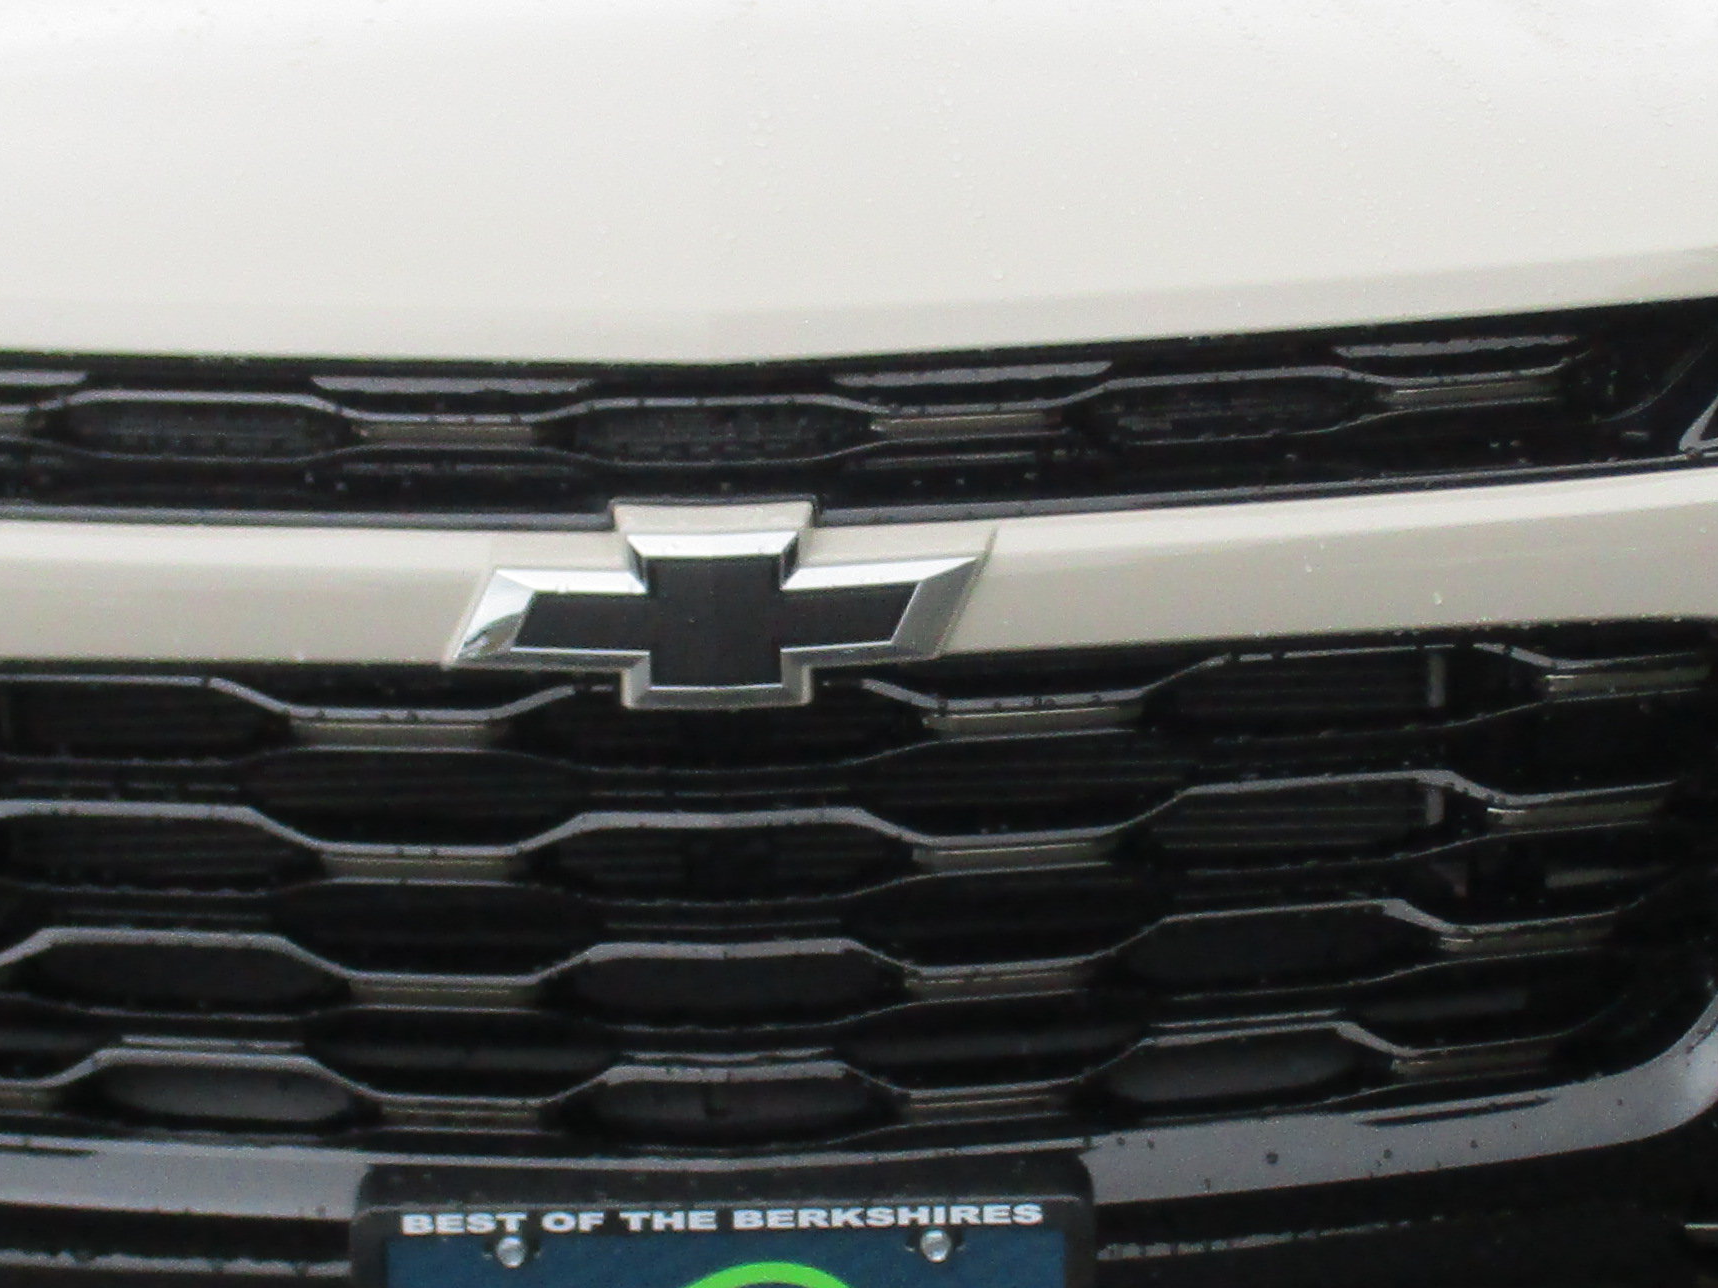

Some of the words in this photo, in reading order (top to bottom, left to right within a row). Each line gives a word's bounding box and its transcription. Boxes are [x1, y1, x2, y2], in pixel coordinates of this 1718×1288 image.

[401, 1213, 526, 1237] BEST
[541, 1212, 605, 1234] OF
[620, 1209, 717, 1232] THE
[732, 1204, 1044, 1231] BERKSHIRES
